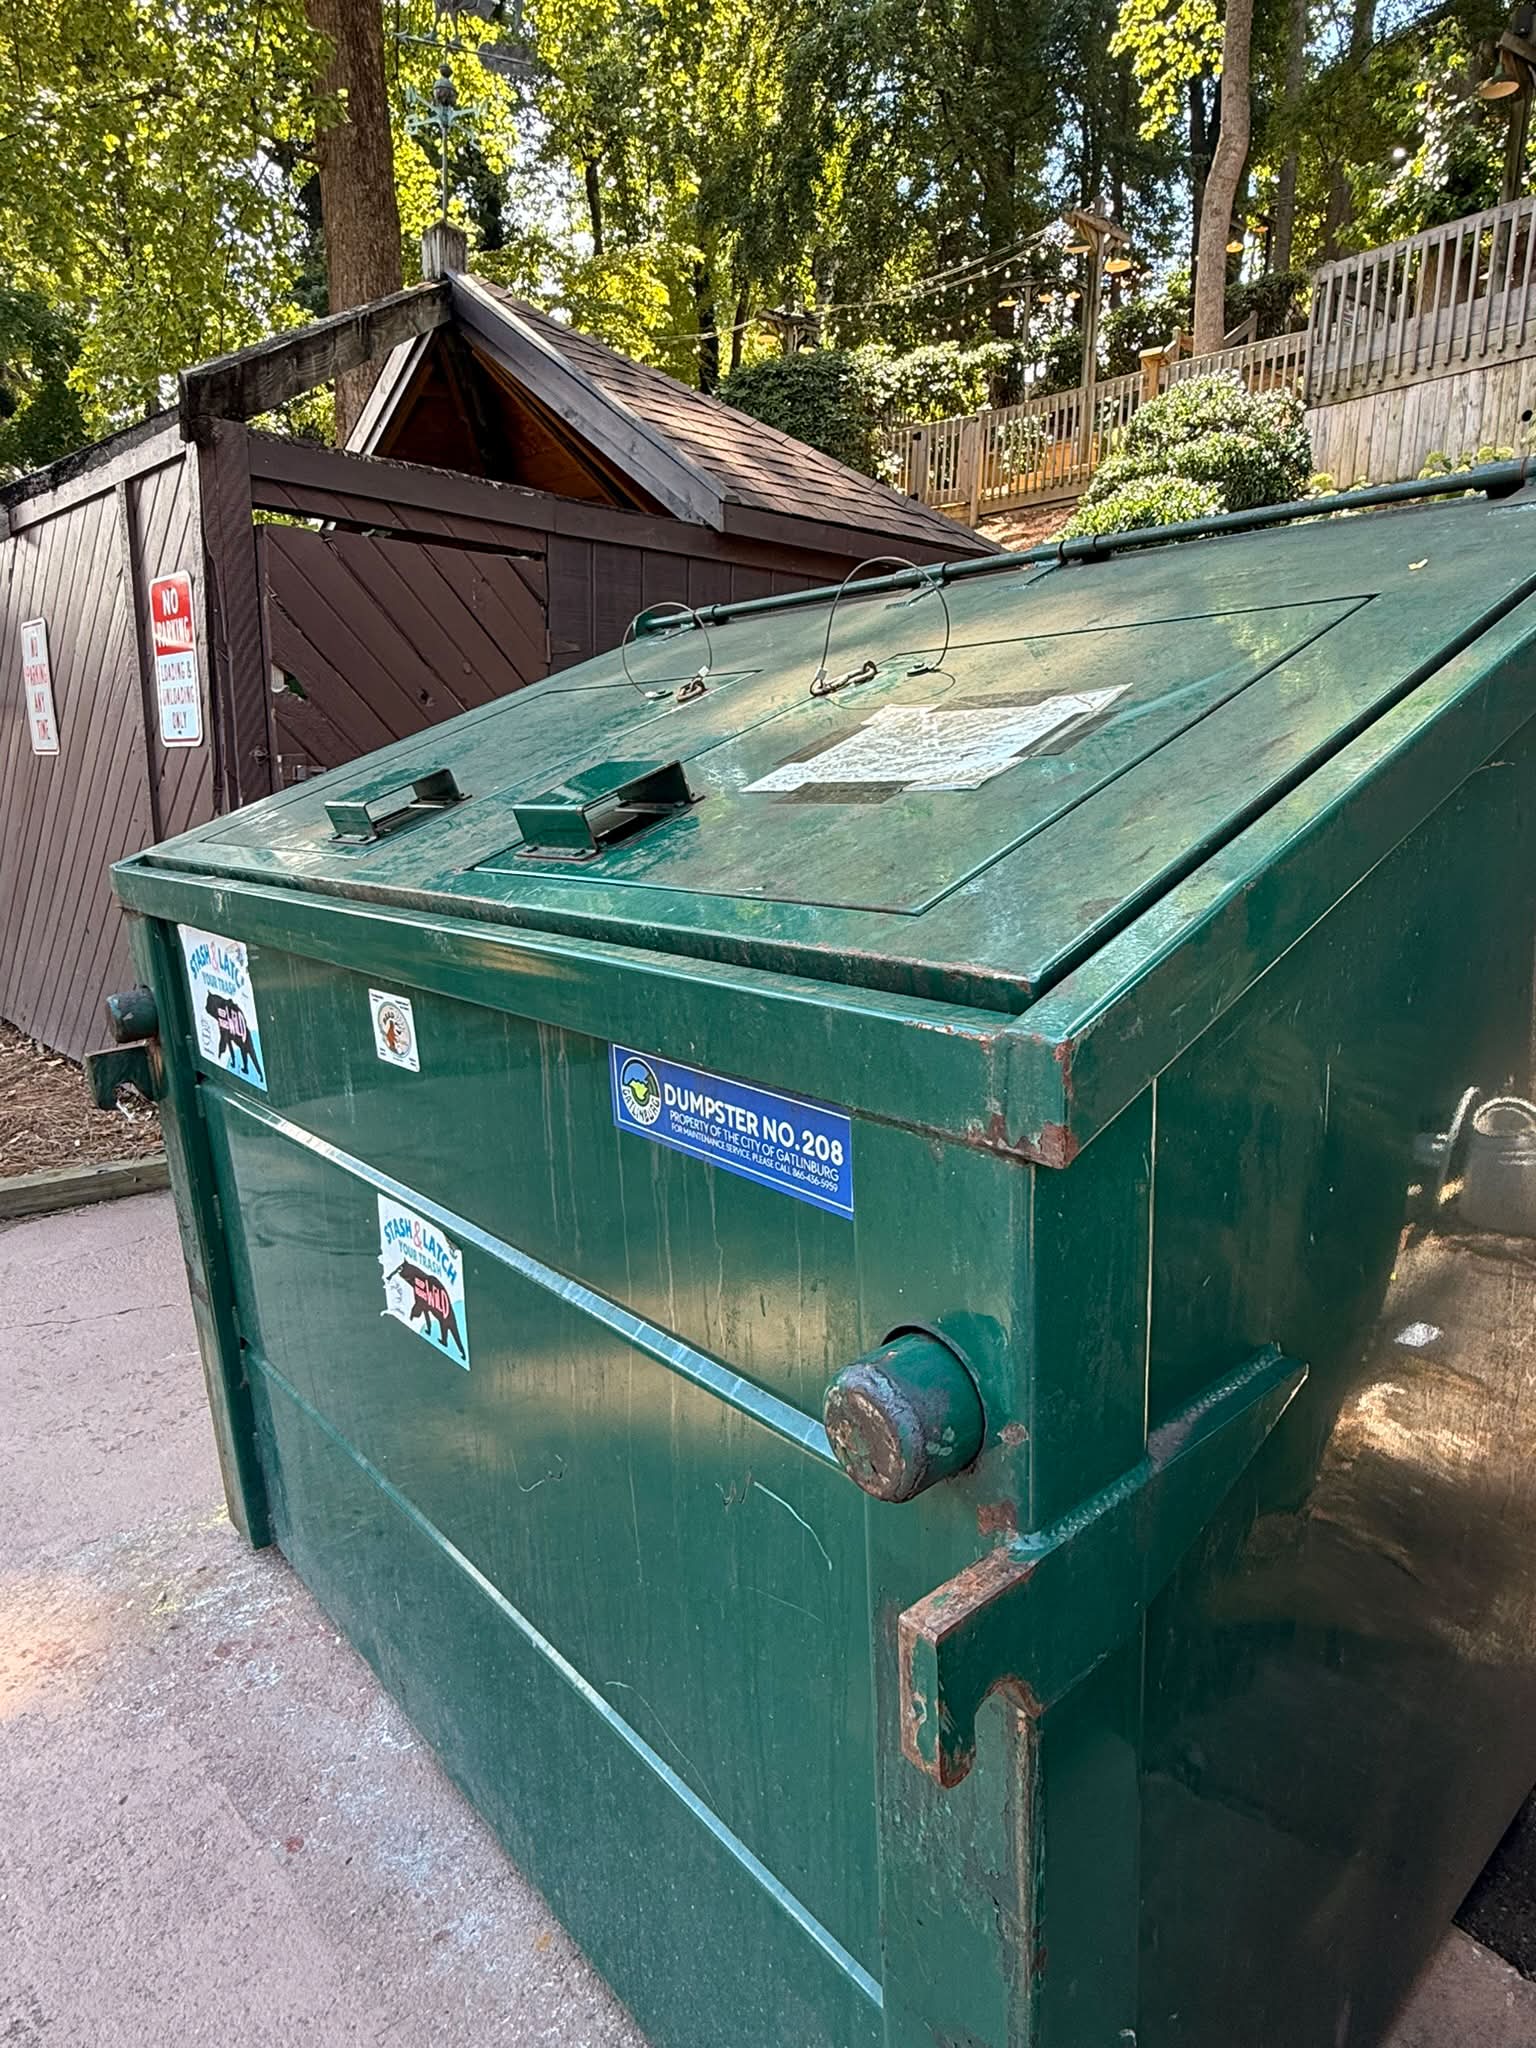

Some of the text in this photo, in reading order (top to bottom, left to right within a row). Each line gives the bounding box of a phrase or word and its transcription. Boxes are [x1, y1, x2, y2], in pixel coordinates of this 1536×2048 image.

[161, 588, 179, 616] NO
[157, 616, 190, 647] PARKING
[160, 661, 186, 682] LOADING
[162, 685, 195, 706] UNLOADING
[172, 711, 187, 730] ONLY
[189, 943, 211, 980] STASH
[209, 941, 220, 972] &
[201, 971, 218, 989] YOUR
[621, 1088, 660, 1124] GATLINBURG
[663, 1082, 759, 1138] DUMPSTER
[669, 1109, 840, 1182] PROPERTY OF THE CITY OF GATLINBURG
[671, 1122, 683, 1134] FOR
[683, 1127, 725, 1151] MAINTENANCE
[752, 1151, 775, 1169] PLEASE
[774, 1160, 792, 1176] CALL
[791, 1167, 839, 1193] 865-436-5959
[383, 1217, 457, 1285] STASH & LATCH
[398, 1239, 443, 1278] YOUR TRASH
